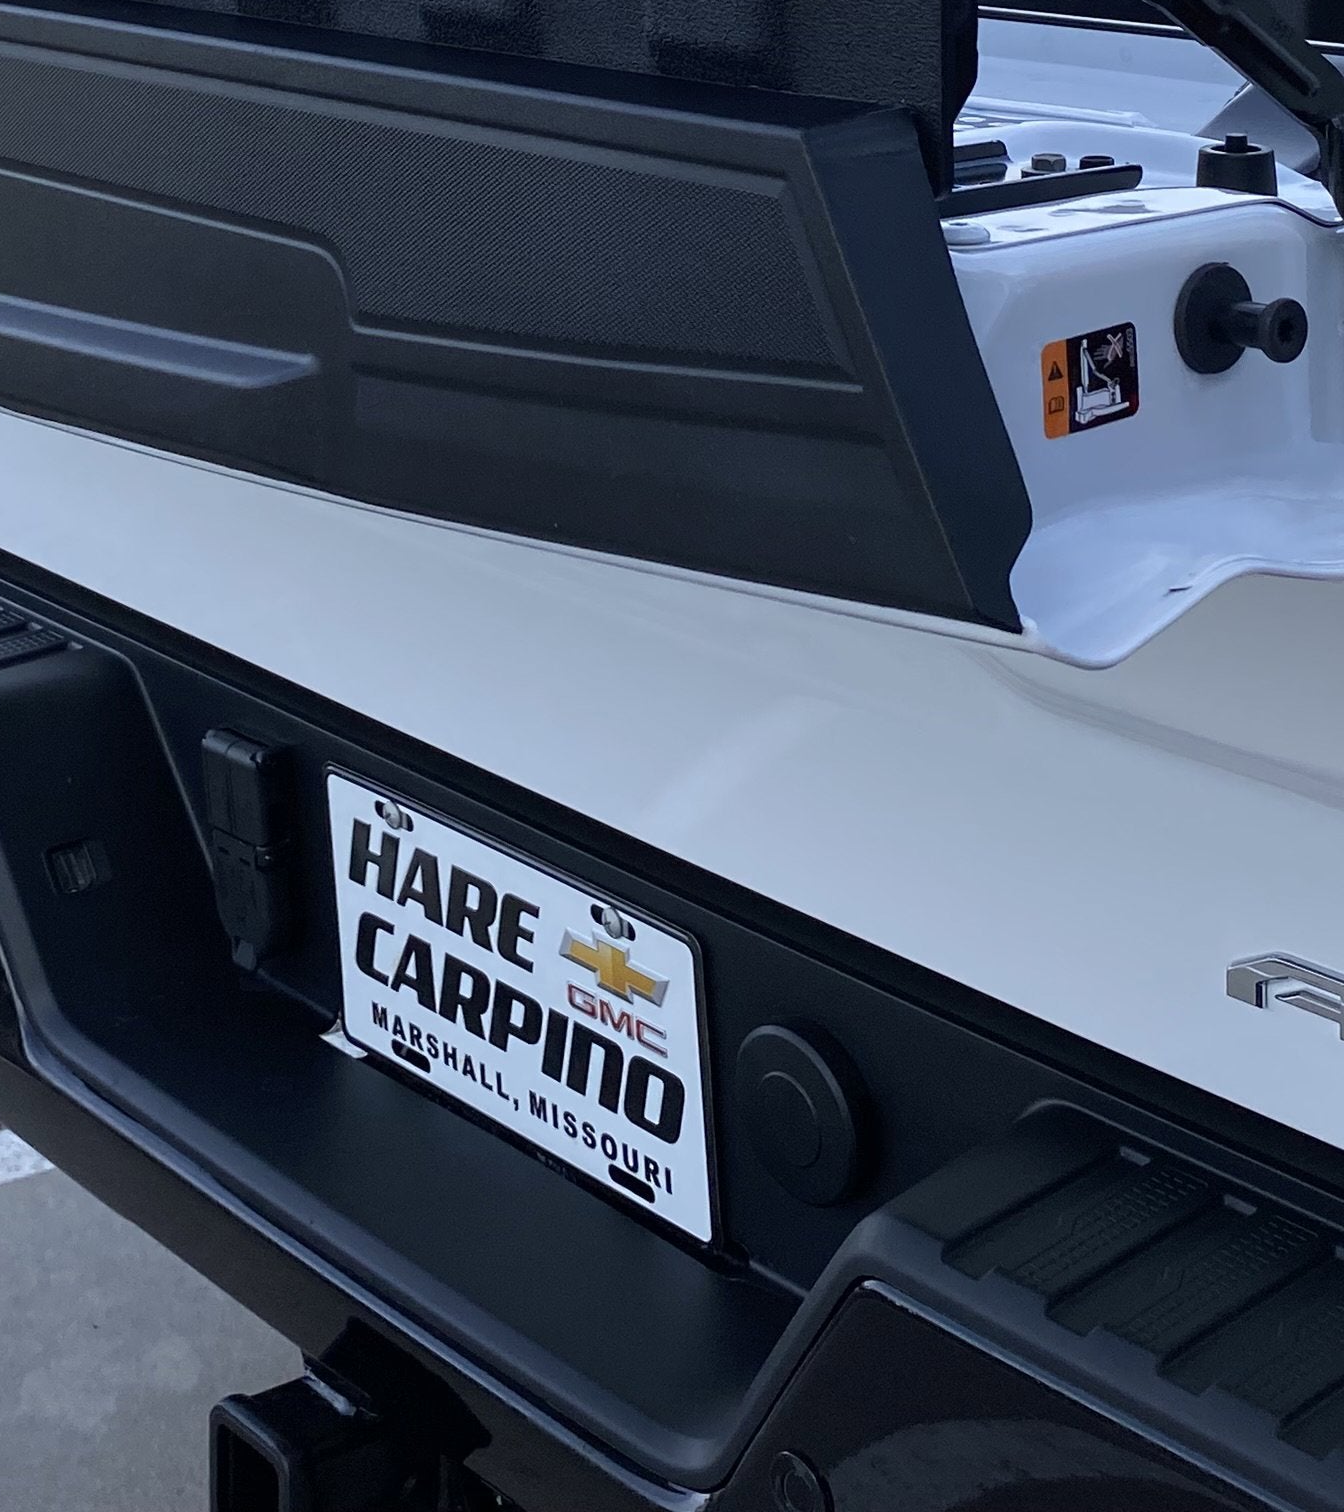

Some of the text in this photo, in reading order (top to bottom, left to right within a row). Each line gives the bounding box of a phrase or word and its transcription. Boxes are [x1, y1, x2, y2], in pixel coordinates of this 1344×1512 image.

[348, 816, 541, 974] HARE
[355, 911, 686, 1145] CARPINO
[370, 1001, 674, 1195] MARSHALL, MISSOURI
[566, 981, 669, 1059] GMC
